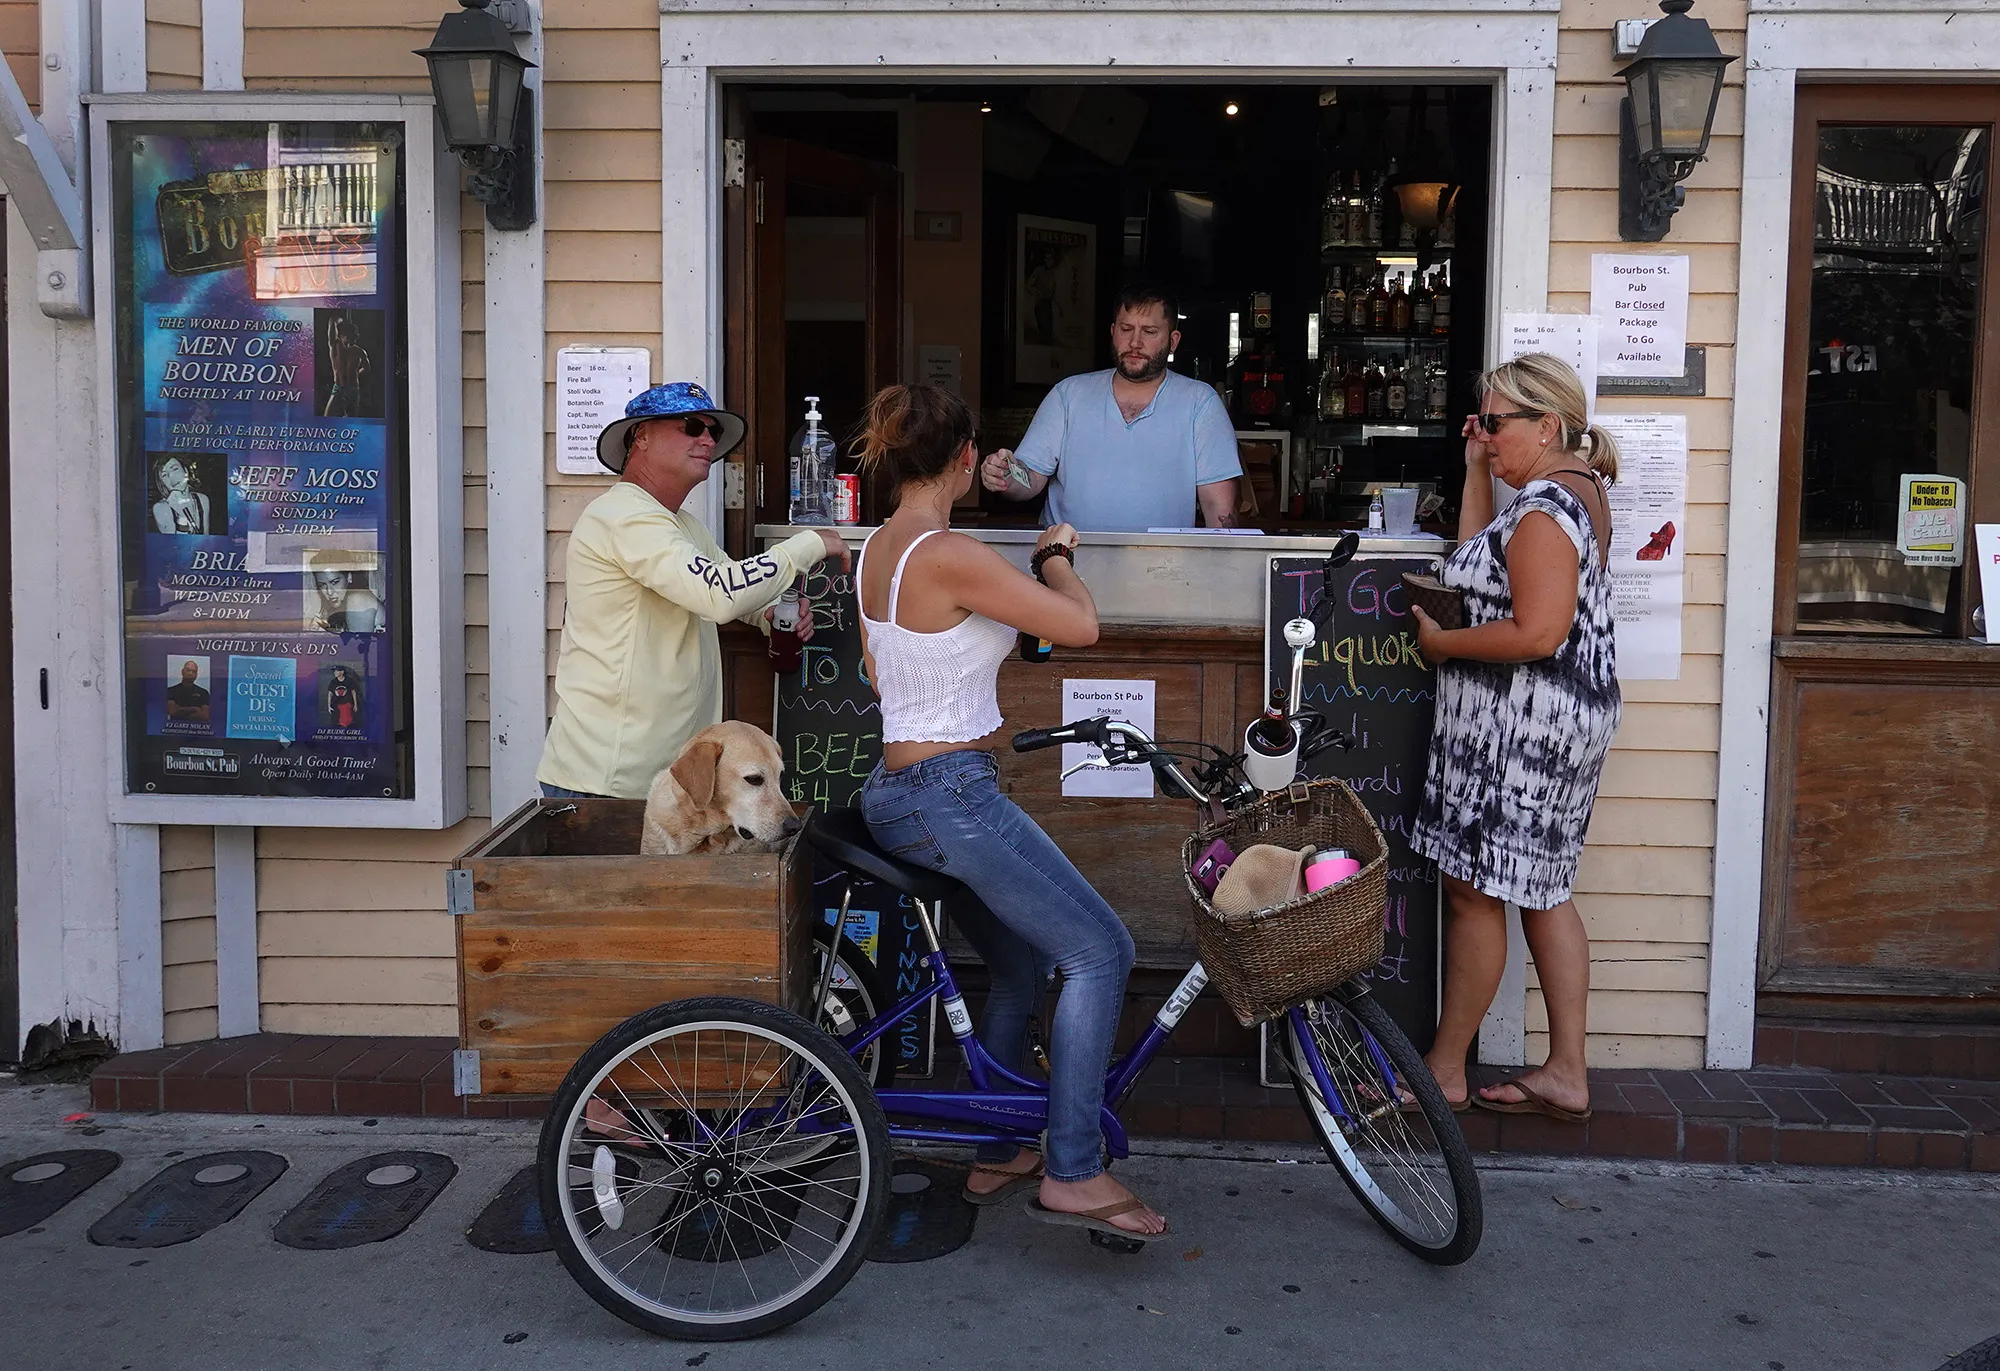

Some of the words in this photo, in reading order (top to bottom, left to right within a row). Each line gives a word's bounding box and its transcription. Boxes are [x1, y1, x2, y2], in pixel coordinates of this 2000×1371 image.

[1613, 266, 1654, 275] Bourbon
[1657, 266, 1670, 275] St.
[1628, 283, 1647, 292] Pub
[1615, 301, 1631, 309] Bar
[1633, 301, 1665, 310] Closed
[159, 317, 186, 328] THE
[189, 318, 240, 330] WORLD
[243, 320, 302, 332] FAMOUS
[1619, 318, 1658, 328] Package
[177, 335, 238, 356] MEN
[244, 337, 283, 357] OF
[1626, 335, 1638, 344] To
[1641, 335, 1654, 344] Go
[1616, 353, 1661, 361] Available
[163, 361, 298, 384] BOURBON
[160, 387, 231, 400] NIGHTLY
[233, 389, 254, 400] AT
[259, 390, 302, 402] 10PM
[173, 424, 213, 435] ENJOY
[215, 425, 233, 436] AN
[236, 425, 277, 437] EARLY
[279, 426, 337, 439] EVENING
[340, 428, 360, 440] OF
[173, 437, 201, 448] LIVE
[204, 438, 247, 450] VOCAL
[249, 440, 355, 453] PERFORMANCES
[229, 465, 298, 487] JEFF
[304, 468, 380, 490] MOSS
[1916, 485, 1938, 494] Under
[1941, 486, 1949, 494] 18
[244, 490, 331, 504] THURSDAY
[333, 492, 365, 505] thru
[1912, 497, 1922, 506] No
[1923, 497, 1953, 506] Tobacco
[272, 507, 338, 519] SUNDAY
[1919, 513, 1946, 527] We
[276, 523, 334, 536] 8-10PM
[1911, 525, 1953, 540] Card
[191, 551, 250, 571] BRIA
[171, 574, 240, 588] MONDAY
[243, 576, 273, 589] thru
[173, 591, 271, 604] WEDNESDAY
[193, 607, 250, 620] 8-10PM
[196, 639, 258, 652] NIGHTLY
[261, 641, 290, 654] VJ'S
[293, 642, 302, 654] &
[307, 643, 338, 656] DJ'S
[245, 664, 289, 684] Special
[803, 645, 840, 688] To
[236, 682, 288, 698] GUEST
[1073, 691, 1112, 700] Bourbon
[1115, 692, 1124, 700] St
[1126, 693, 1143, 701] Pub
[249, 698, 276, 713] DJ's
[1097, 707, 1122, 715] Package
[249, 753, 291, 768] Always
[294, 756, 303, 768] A
[306, 757, 340, 768] Good
[343, 758, 376, 769] Time!
[796, 732, 878, 778] BEE
[166, 755, 204, 771] Bourbon
[206, 758, 217, 772] St.
[219, 759, 238, 772] Pub
[262, 768, 286, 778] Open
[289, 769, 314, 780] Daily
[317, 770, 365, 780] 10AM-4AM
[1387, 860, 1437, 883] aniels
[897, 893, 920, 1058] GUINNSS
[1166, 974, 1206, 1018] Sun
[968, 1100, 1048, 1118] traditional
